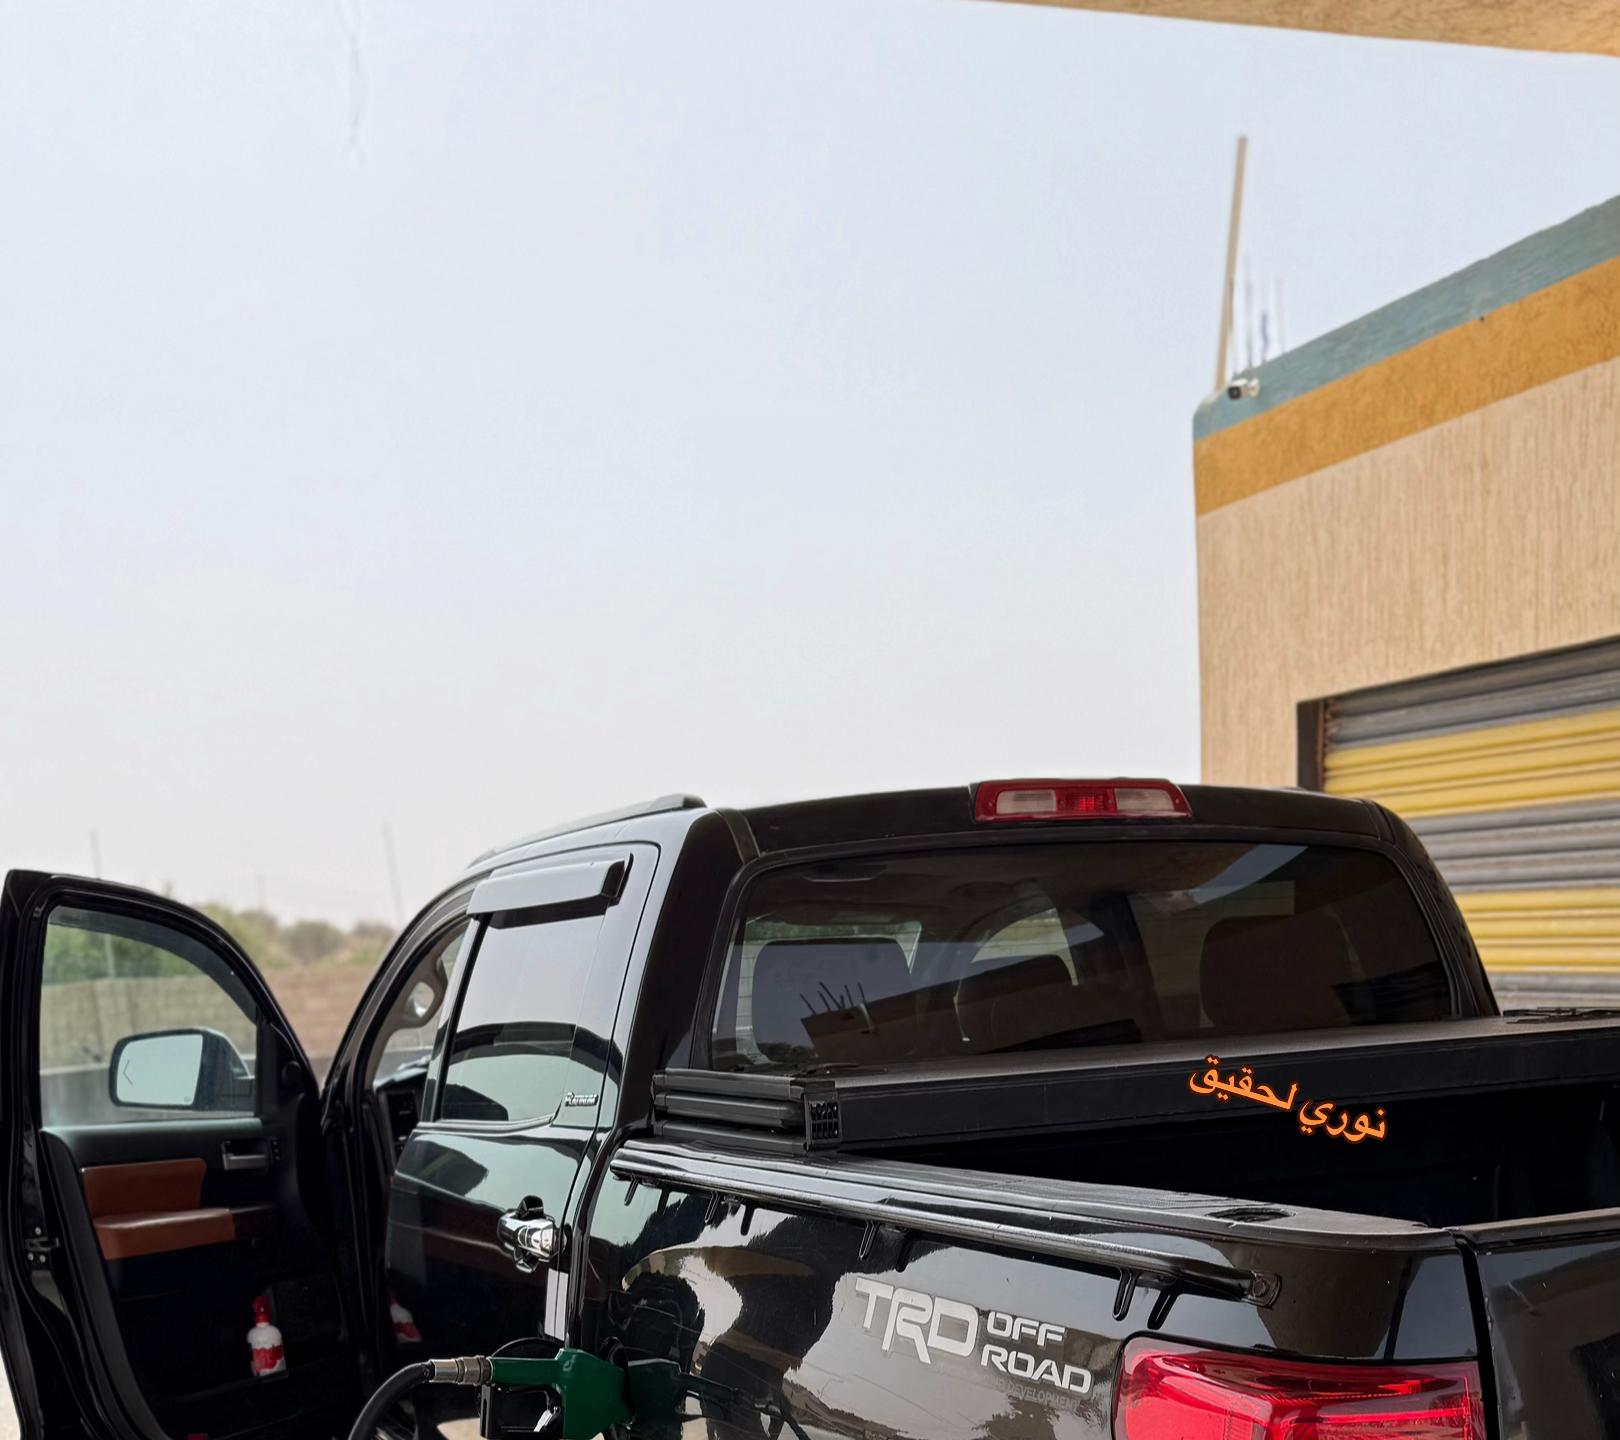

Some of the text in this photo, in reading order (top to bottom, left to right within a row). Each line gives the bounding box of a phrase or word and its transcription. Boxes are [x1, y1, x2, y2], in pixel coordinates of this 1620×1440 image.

[855, 1277, 979, 1365] TRD
[987, 1311, 1066, 1347] OFF
[981, 1344, 1092, 1394] ROAD
